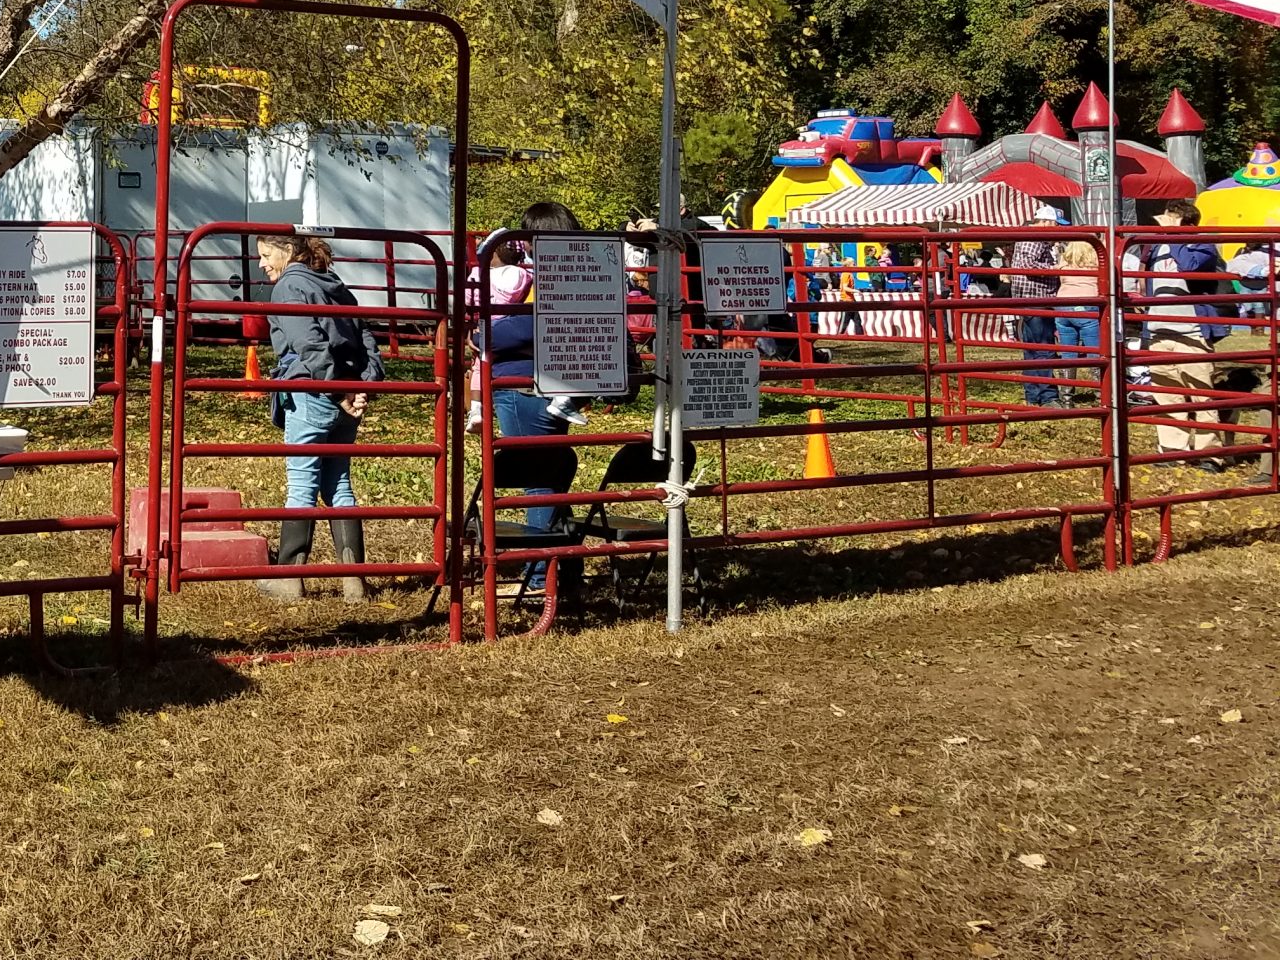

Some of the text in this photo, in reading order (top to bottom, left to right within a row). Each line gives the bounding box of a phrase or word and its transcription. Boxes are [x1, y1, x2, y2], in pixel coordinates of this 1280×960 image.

[569, 243, 590, 251] RULES
[733, 266, 769, 274] TICKETS
[724, 277, 780, 285] WRISTBANDS
[736, 288, 770, 296] PASSES
[63, 295, 85, 303] $17.00
[749, 299, 770, 307] ONLY
[65, 307, 85, 315] $8.00
[3, 339, 68, 347] COMBO PACKAGE
[59, 357, 85, 365] $20.00
[35, 378, 56, 386] $2.00
